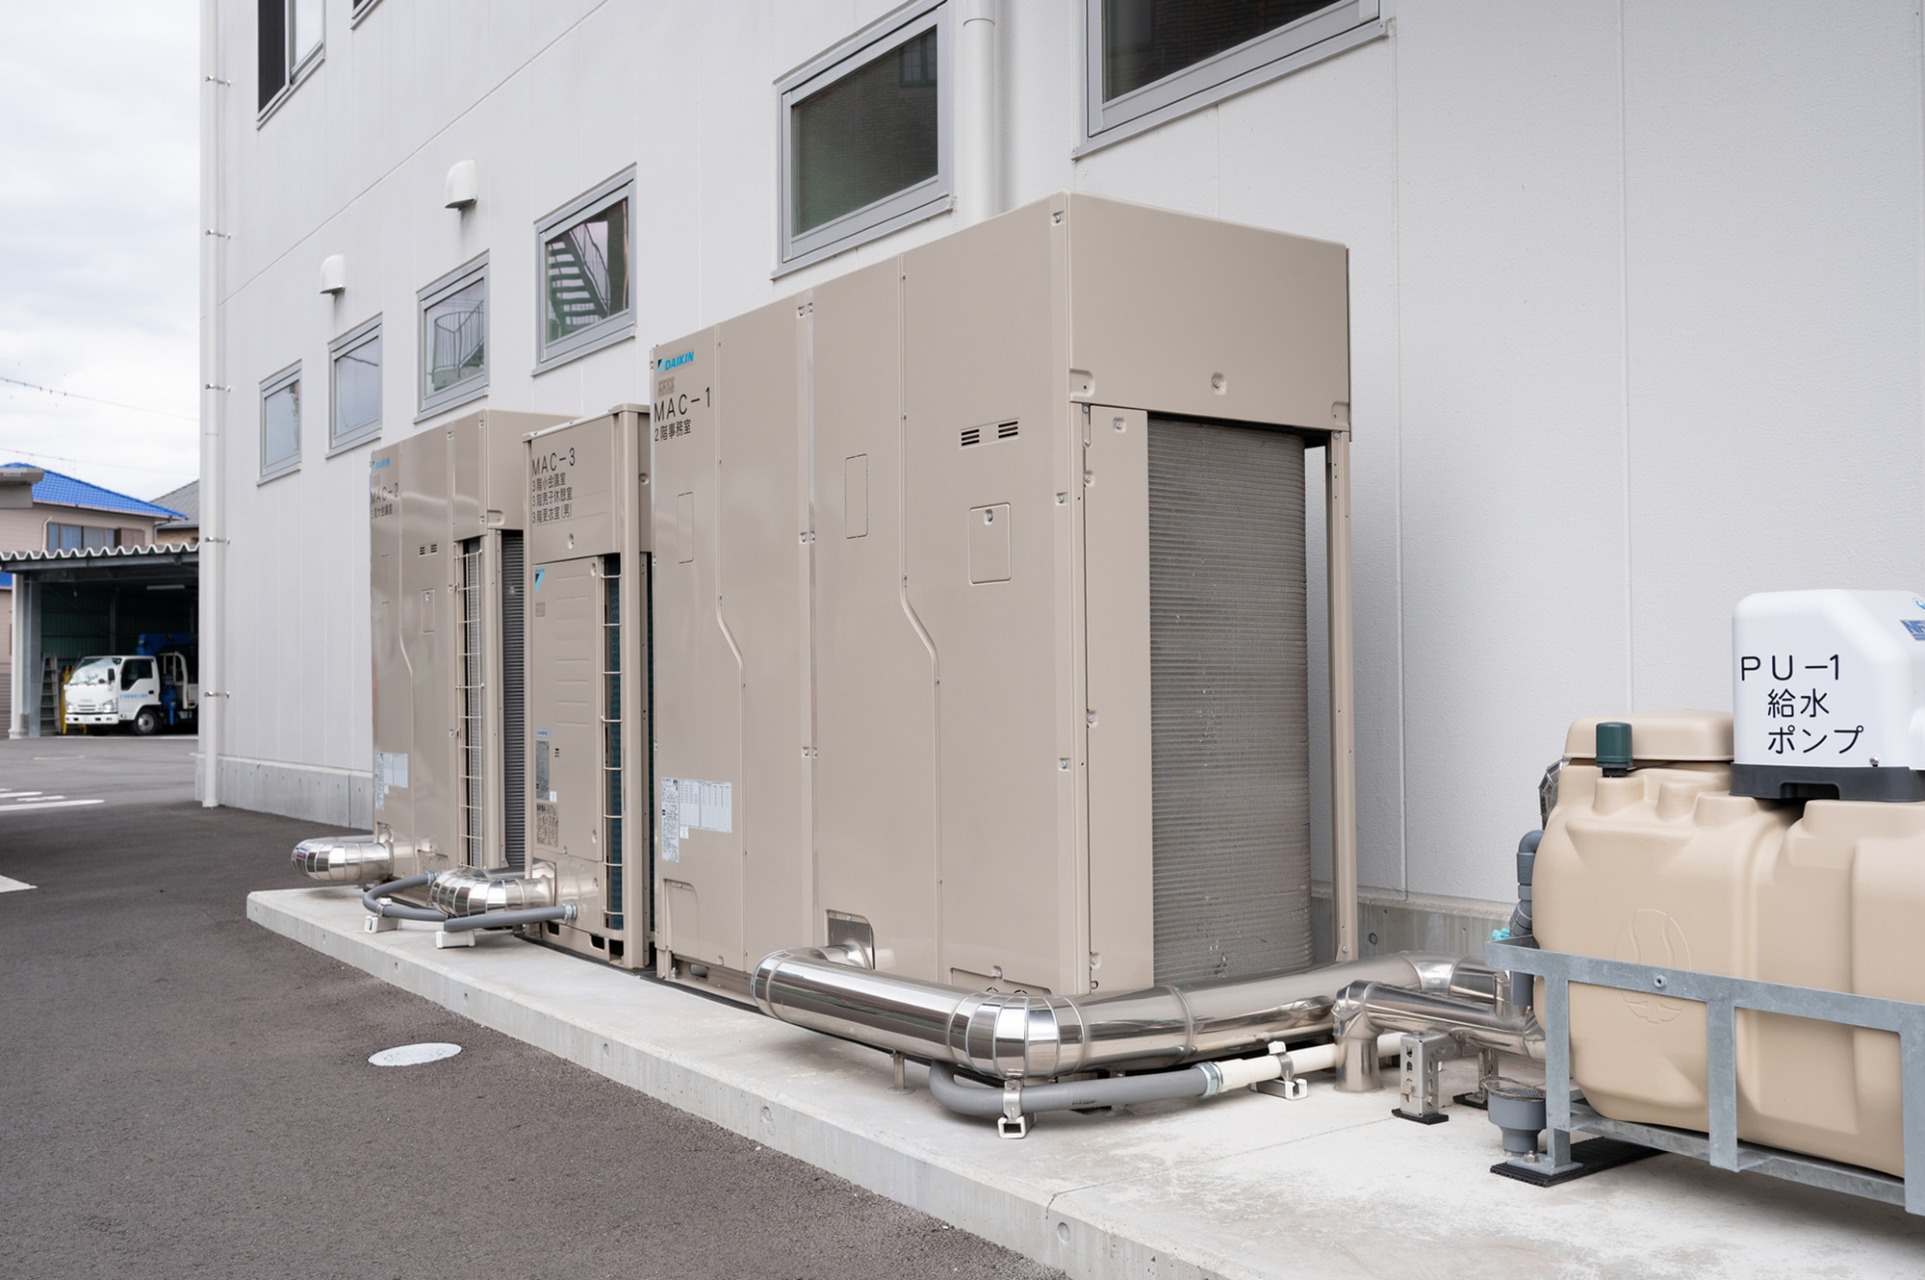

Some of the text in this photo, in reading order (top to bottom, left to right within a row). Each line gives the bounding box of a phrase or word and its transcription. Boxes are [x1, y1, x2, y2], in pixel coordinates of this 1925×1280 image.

[664, 351, 695, 371] DAIKIN
[654, 386, 711, 423] MAC-1
[654, 419, 692, 442] 2階事務室
[532, 447, 576, 477] MAC-3
[370, 482, 399, 504] MAC-2
[1767, 688, 1830, 719] 給水
[1767, 724, 1865, 755] ポンプ
